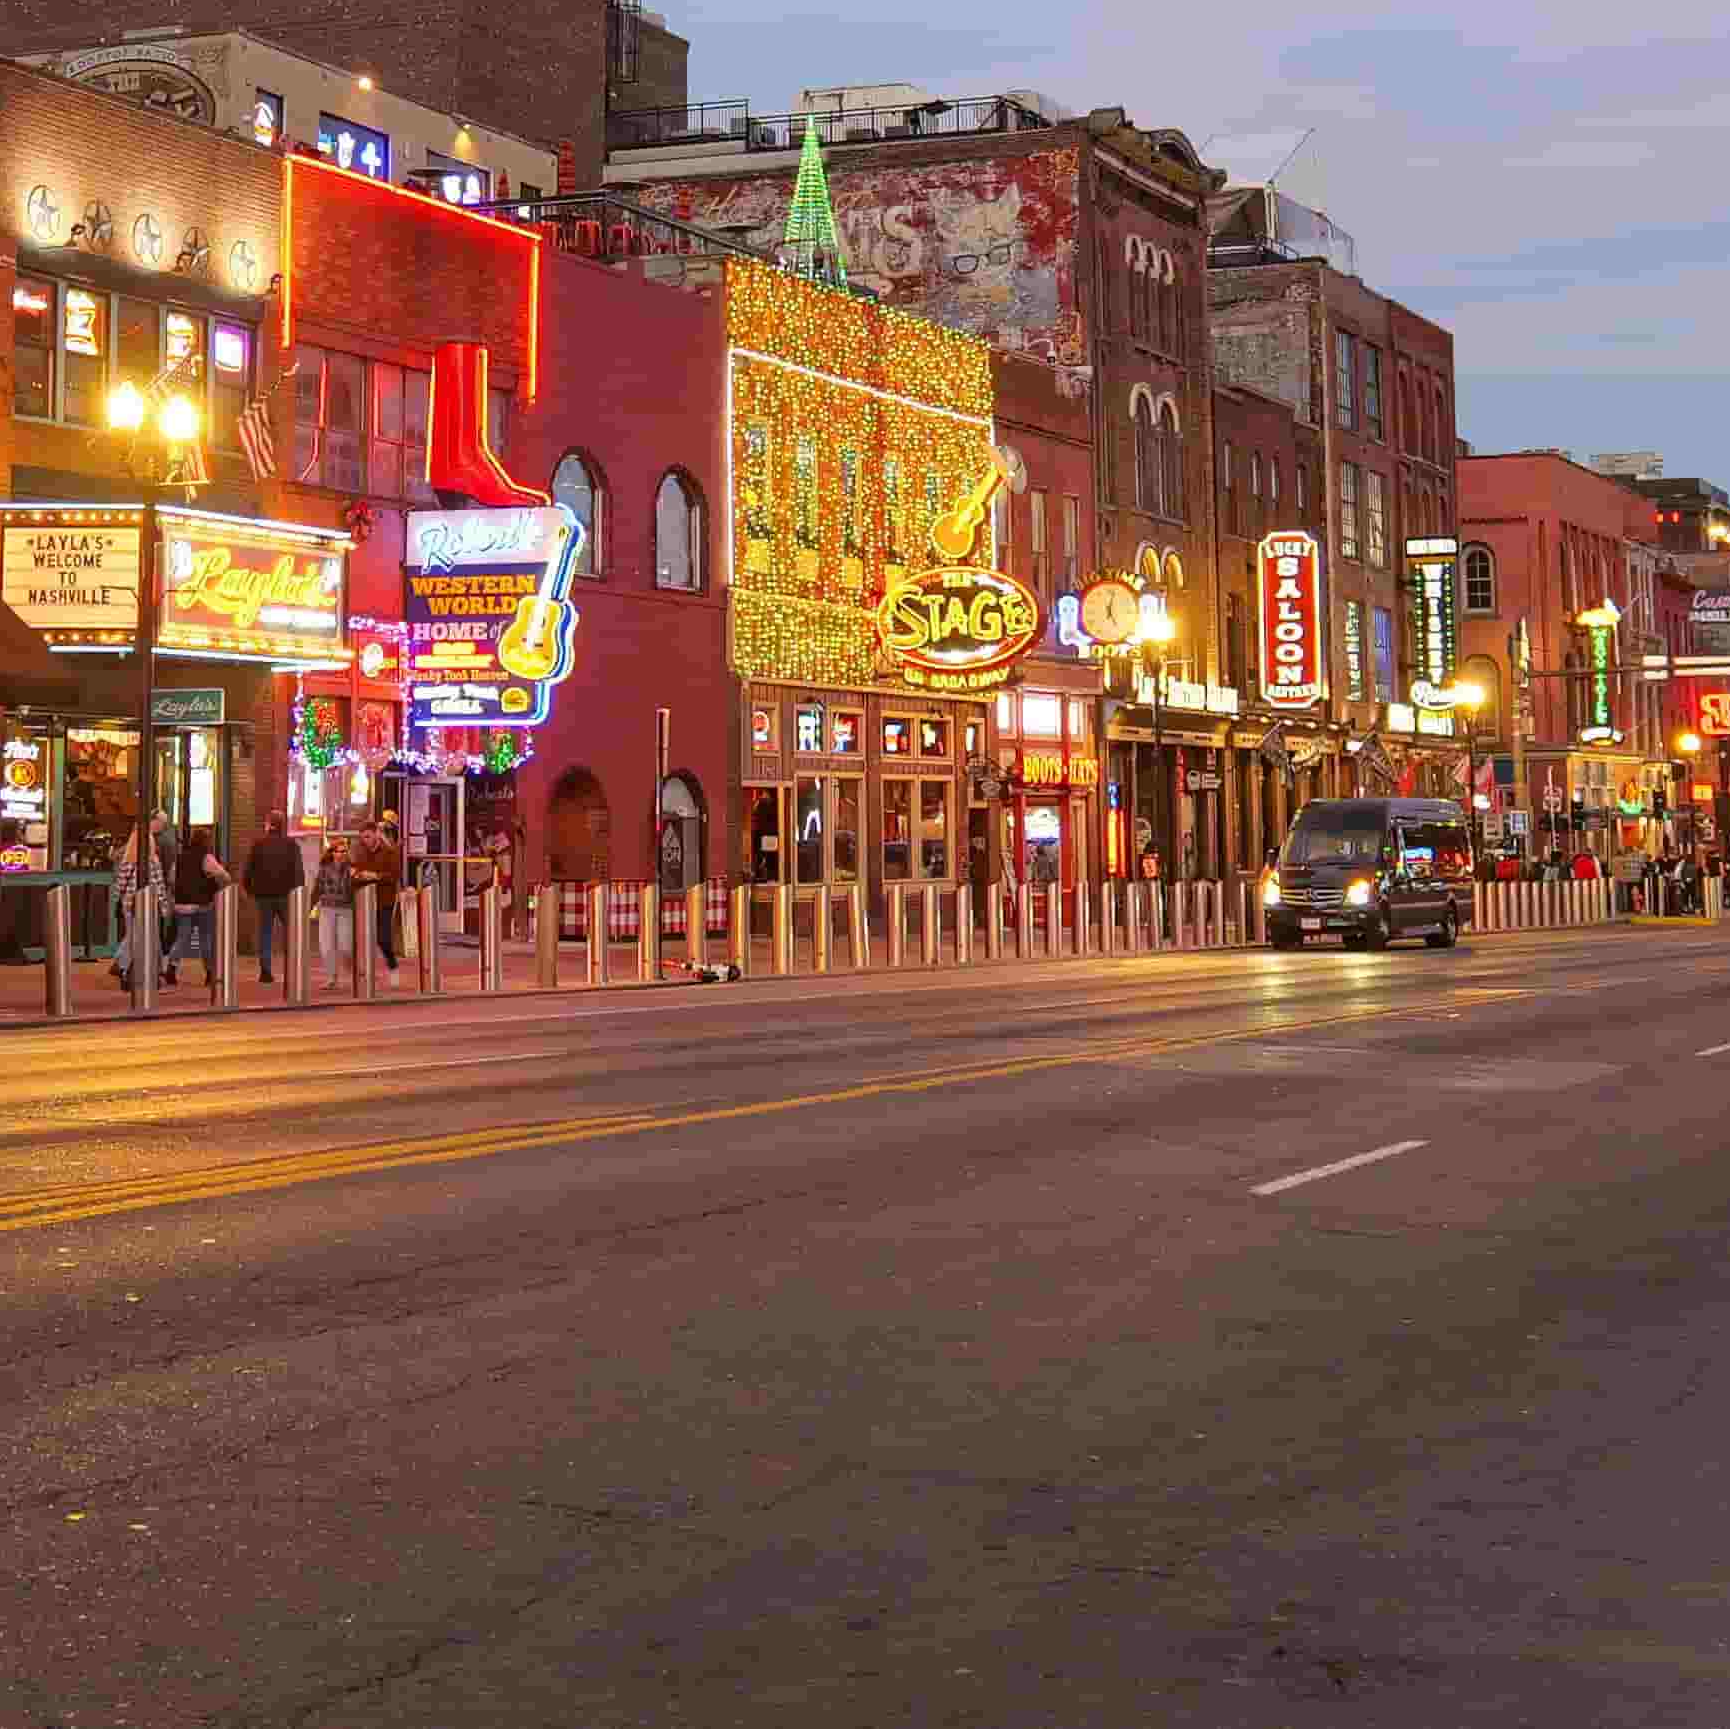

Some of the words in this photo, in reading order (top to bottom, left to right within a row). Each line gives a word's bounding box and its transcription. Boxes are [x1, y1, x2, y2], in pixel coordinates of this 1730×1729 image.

[37, 535, 104, 551] LAYLA'S
[33, 553, 104, 568] WELCOME
[58, 571, 78, 587] TO
[411, 573, 537, 596] WESTERN
[28, 589, 111, 606] NASHVILLE
[427, 597, 518, 615] WORLD
[889, 583, 1033, 652] STAGE
[1275, 557, 1304, 686] SALOON
[413, 622, 488, 641] HOME
[1022, 754, 1062, 784] BOOTS
